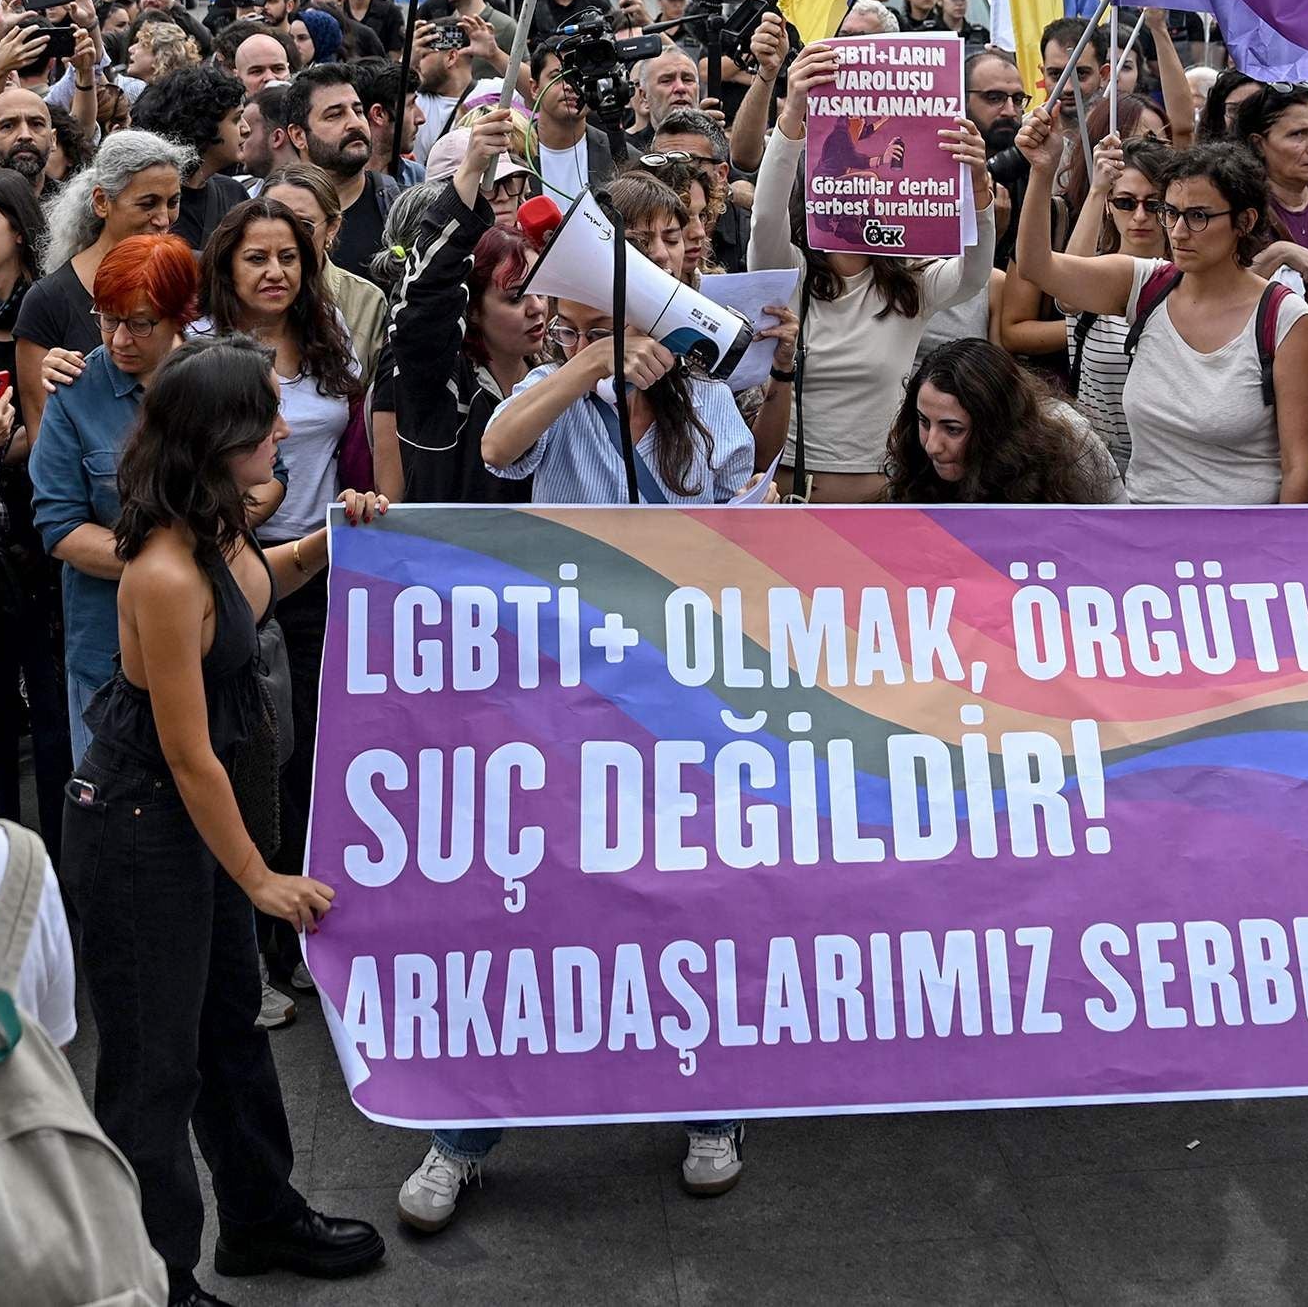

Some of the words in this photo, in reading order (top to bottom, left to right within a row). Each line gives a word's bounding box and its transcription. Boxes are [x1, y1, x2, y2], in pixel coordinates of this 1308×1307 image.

[836, 43, 946, 66] GBTİ+LARIN
[834, 70, 934, 95] VAROLUŞU
[811, 176, 894, 195] Gözaltılar
[898, 177, 954, 196] derhal
[806, 198, 869, 215] serbest
[874, 198, 961, 217] bırakılsın!
[346, 562, 639, 695] LGBTİ+
[664, 585, 989, 694] OLMAK,
[343, 740, 546, 914] SUÇ
[579, 704, 1113, 874] DEĞİLDİR!
[342, 926, 1064, 1077] ARKADAŞLARIMIZ
